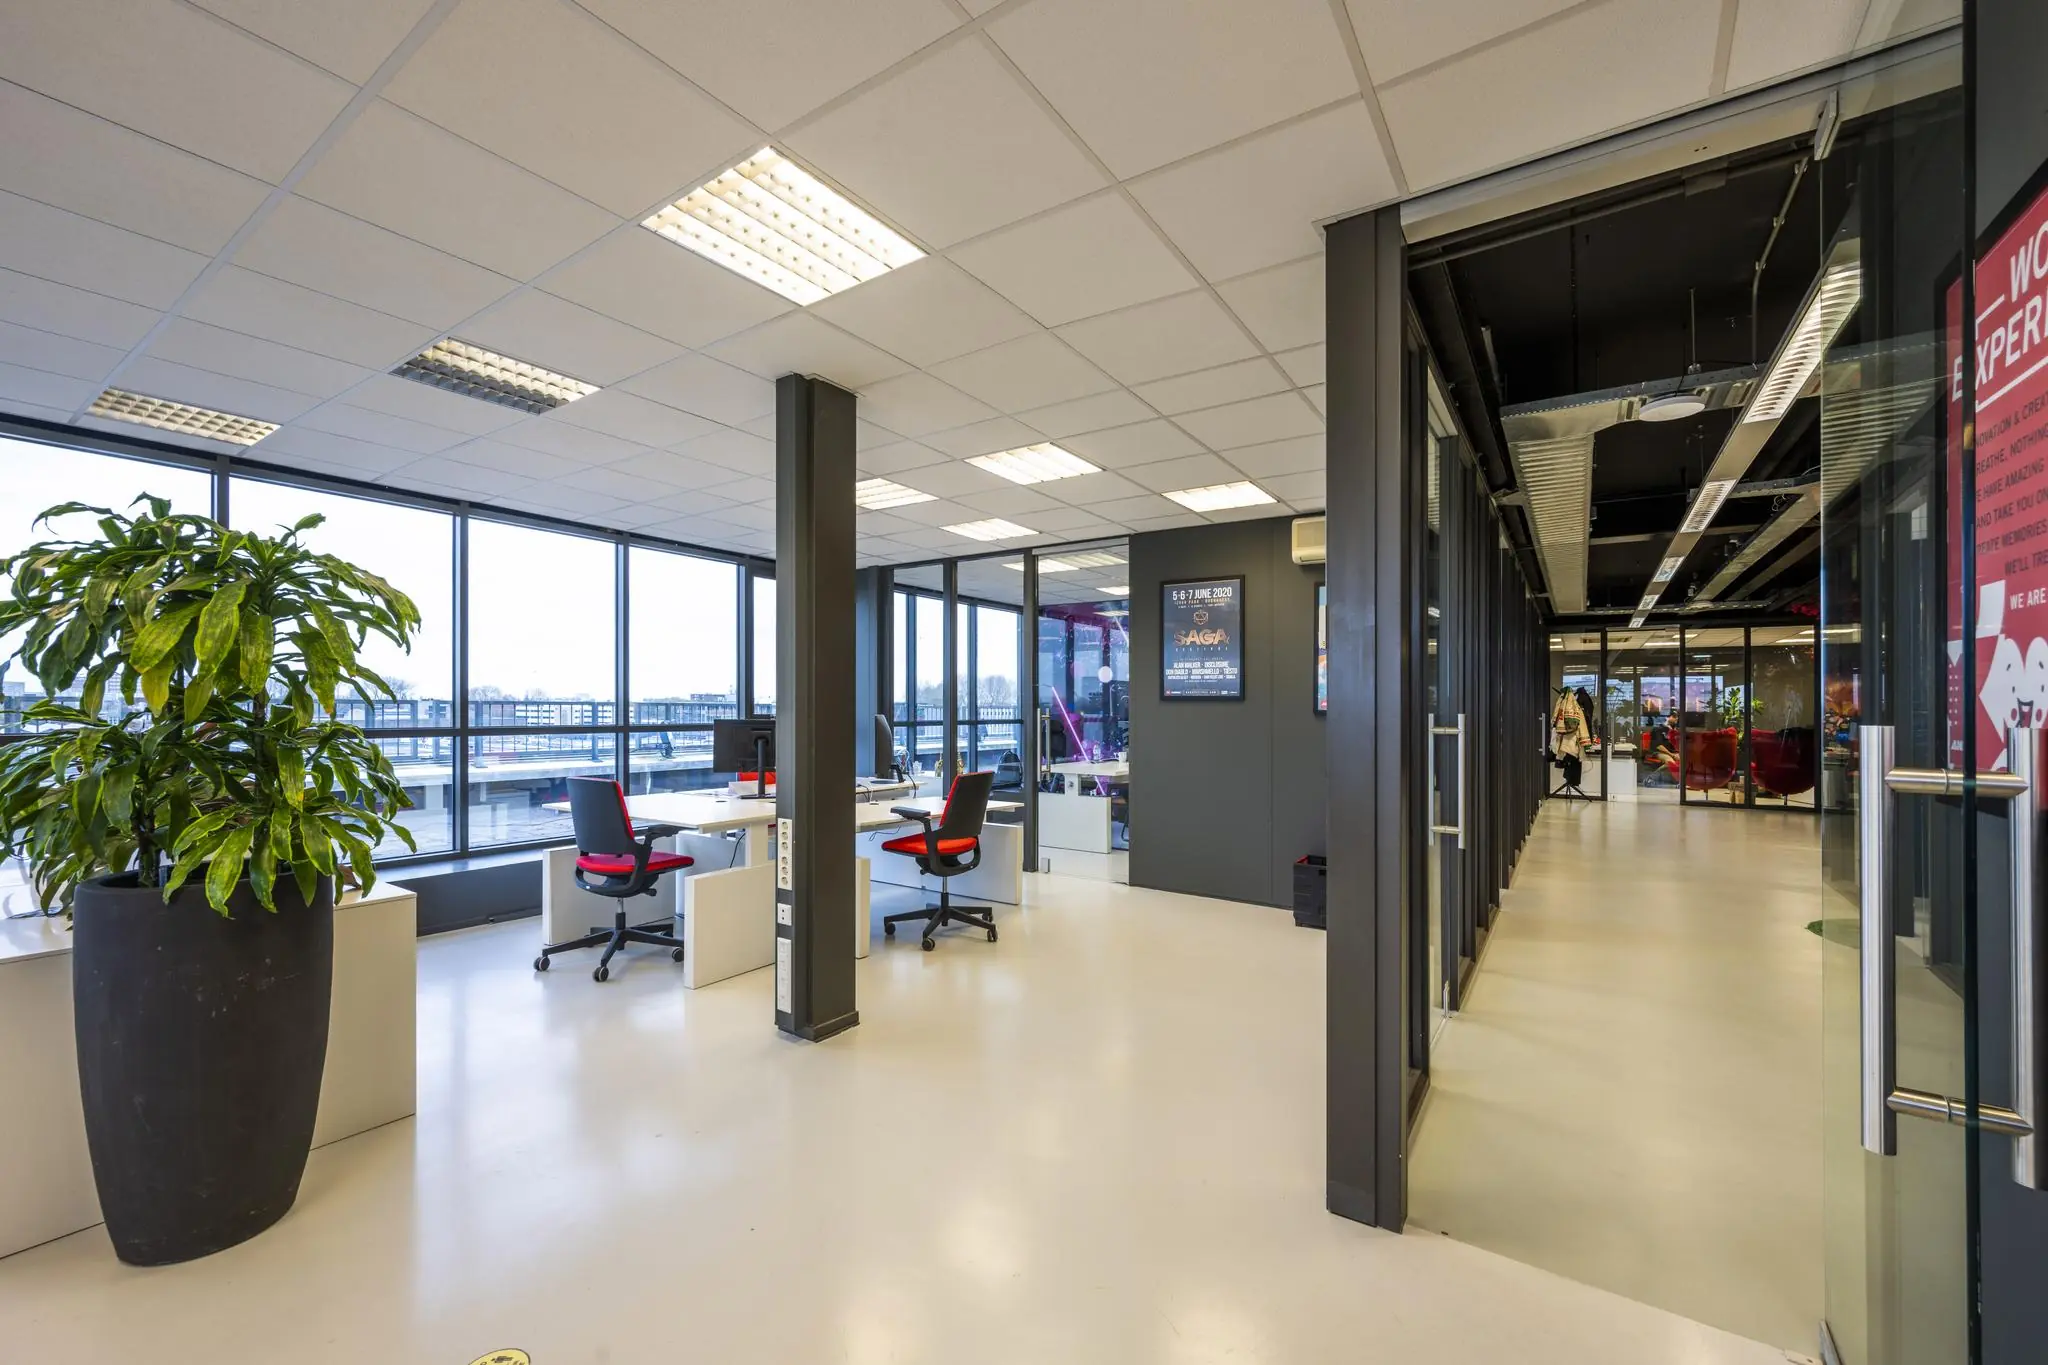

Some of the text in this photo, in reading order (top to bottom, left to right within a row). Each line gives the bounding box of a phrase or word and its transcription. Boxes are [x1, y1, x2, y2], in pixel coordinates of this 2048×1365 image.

[2005, 457, 2044, 488] AMAZING
[1993, 502, 2014, 525] TAKE
[2016, 495, 2034, 513] YOU
[2001, 519, 2047, 548] MEMORIES
[1194, 588, 1212, 599] JUNE
[1213, 586, 1233, 598] 2020
[2010, 587, 2047, 611] WE ARE
[1174, 628, 1231, 646] SAGA
